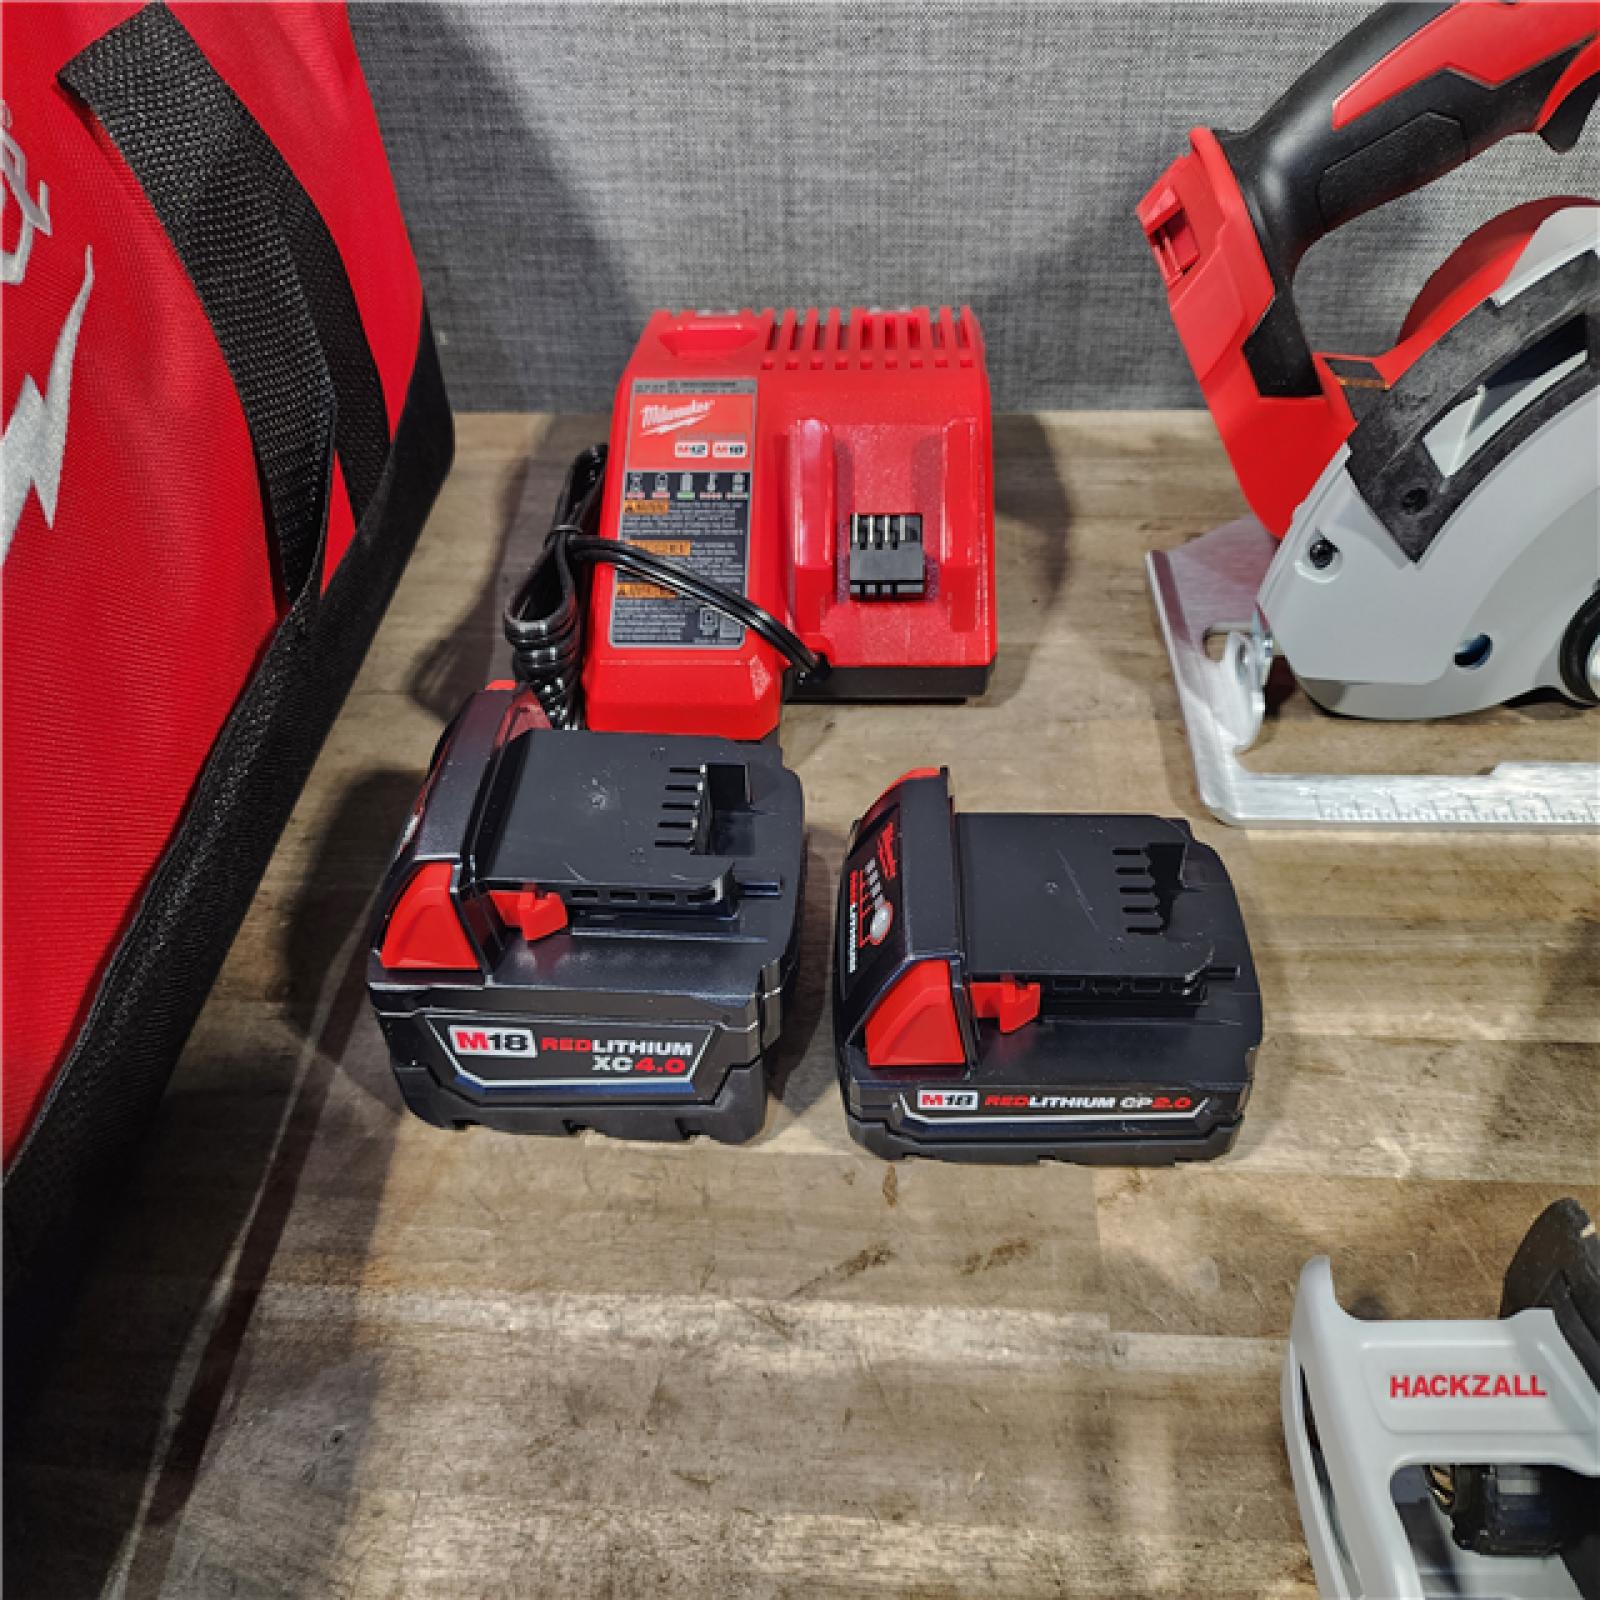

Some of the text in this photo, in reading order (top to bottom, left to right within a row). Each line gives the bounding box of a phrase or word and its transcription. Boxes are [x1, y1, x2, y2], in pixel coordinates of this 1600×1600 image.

[455, 1031, 694, 1056] M18 REDLITHIUM
[592, 1055, 686, 1073] XC4.0
[984, 1094, 1116, 1109] REDLITHIUM
[1390, 1374, 1548, 1398] HACKZALL
